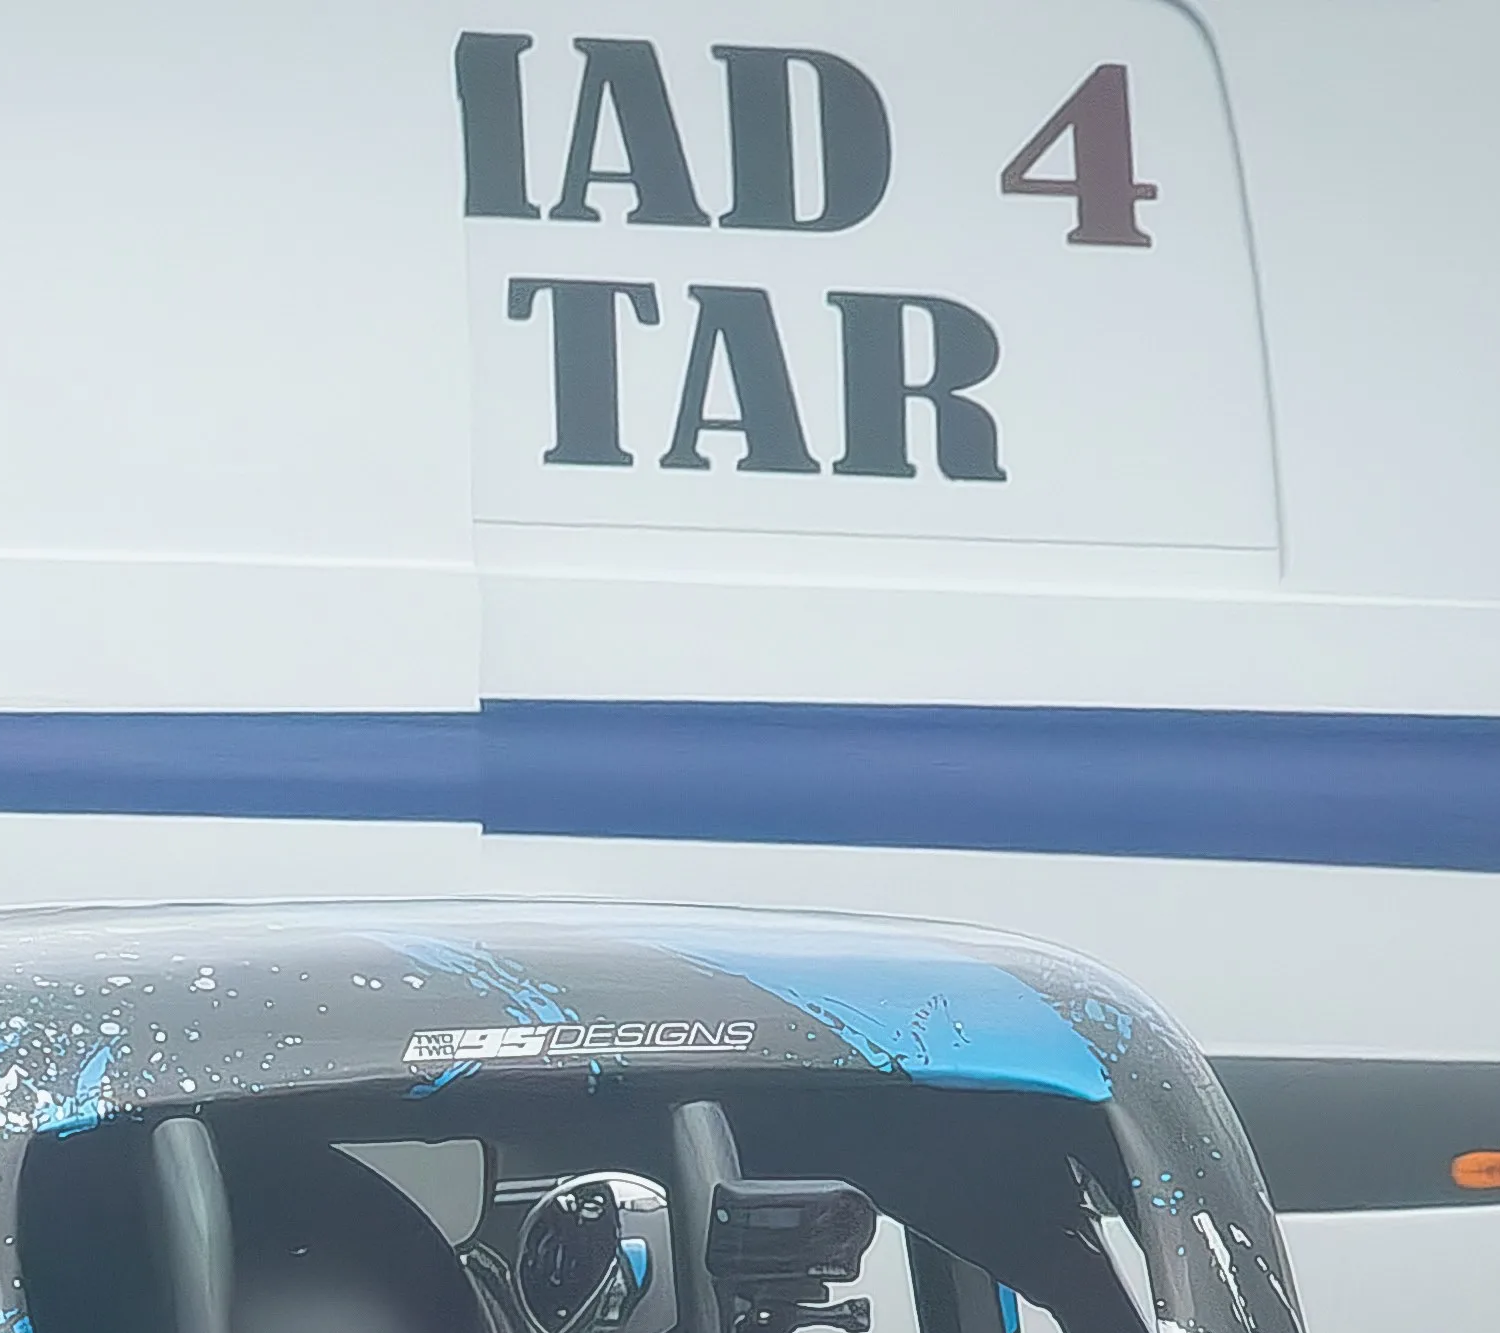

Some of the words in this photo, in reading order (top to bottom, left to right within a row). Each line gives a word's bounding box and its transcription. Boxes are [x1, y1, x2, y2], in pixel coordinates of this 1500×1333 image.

[1001, 64, 1159, 248] 4
[507, 276, 1007, 482] TAR
[547, 1021, 756, 1049] DESIGNS
